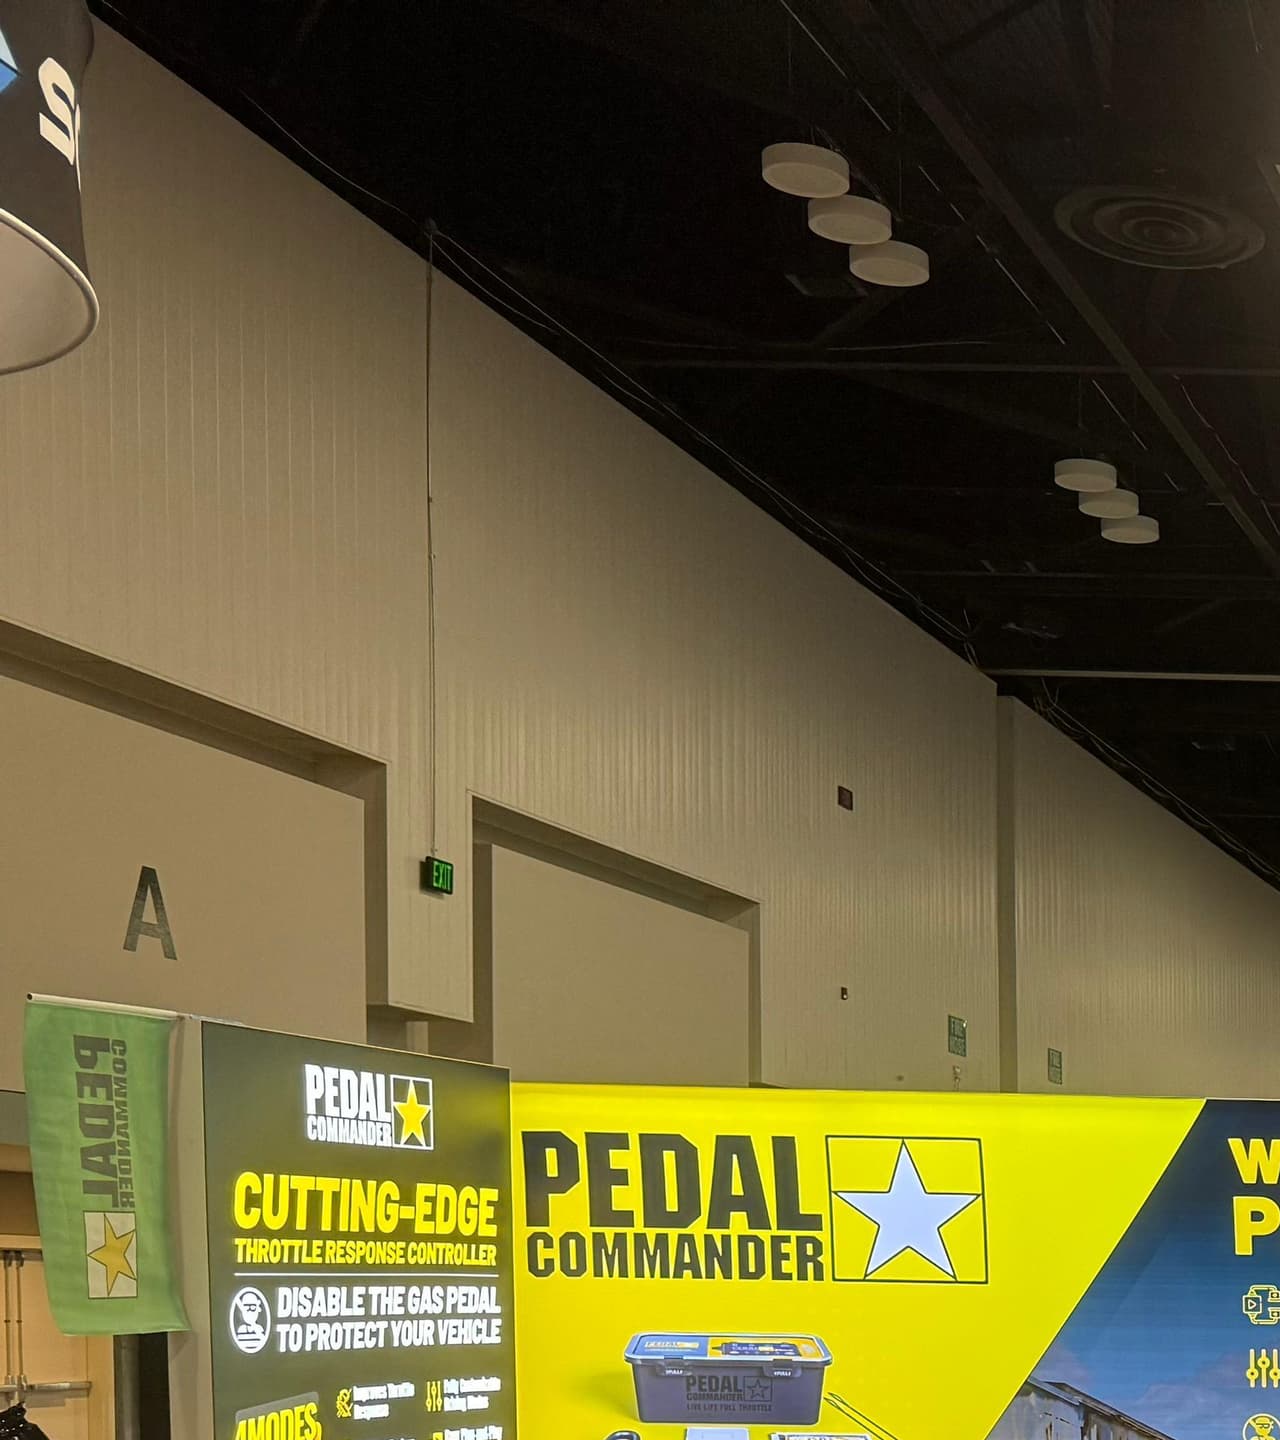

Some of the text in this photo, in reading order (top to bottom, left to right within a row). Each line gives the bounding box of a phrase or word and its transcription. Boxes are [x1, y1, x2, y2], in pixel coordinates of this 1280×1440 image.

[432, 862, 453, 892] EXIT
[123, 866, 178, 960] A
[305, 1064, 392, 1123] PEDAL
[306, 1115, 393, 1148] COMMANDER
[521, 1130, 823, 1231] PEDAL
[234, 1171, 499, 1237] CUTTING-EDGE
[234, 1238, 496, 1266] THROTTLE RESPONSE CONTROLLER
[526, 1231, 825, 1283] COMMANDER
[277, 1286, 501, 1318] DISABLE THE GAS PEDAL
[276, 1318, 502, 1352] TO PROTECT YOUR VEHICLE
[686, 1374, 743, 1393] PEDAL
[686, 1392, 745, 1402] COMMANDER
